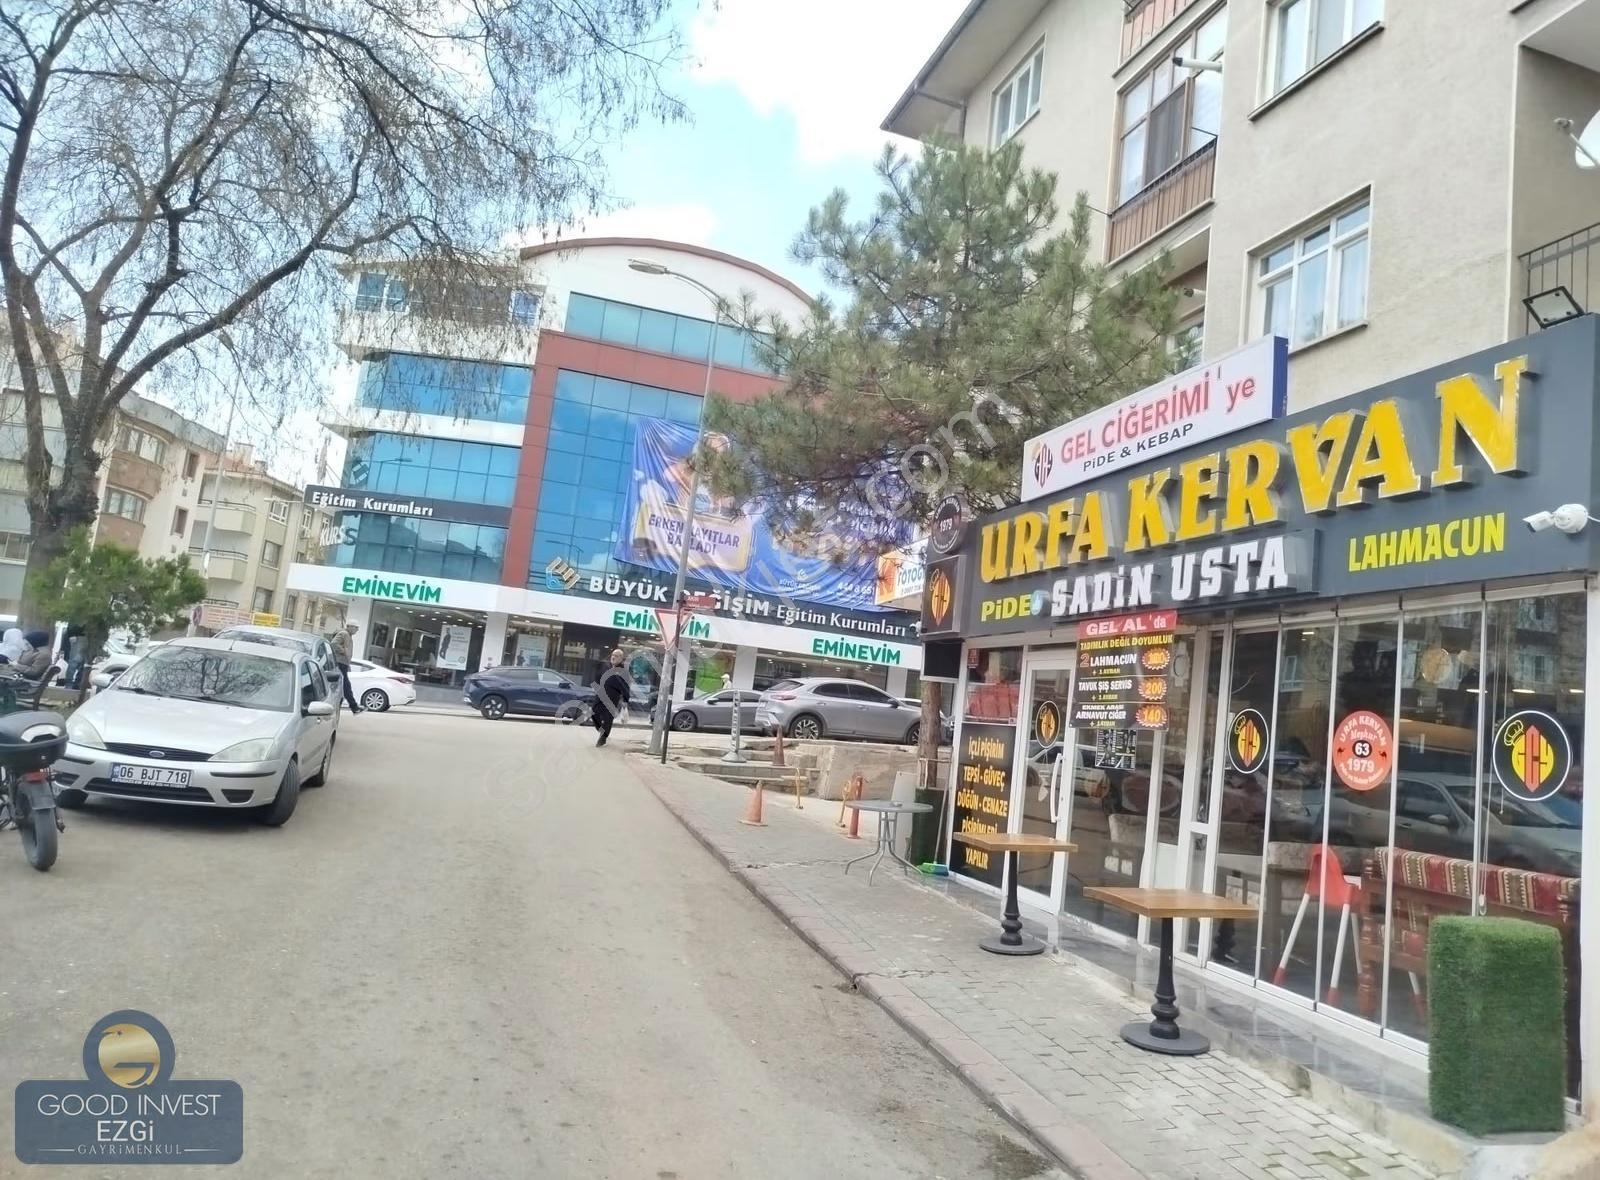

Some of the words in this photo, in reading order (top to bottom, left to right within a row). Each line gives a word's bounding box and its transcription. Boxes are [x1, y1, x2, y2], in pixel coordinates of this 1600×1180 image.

[1061, 435, 1096, 464] GEL
[1101, 372, 1210, 449] CİĞERİMİ
[1120, 446, 1131, 459] &
[1137, 422, 1193, 453] KEBAP
[980, 490, 1110, 583] URFA
[1125, 354, 1528, 553] KERVAN
[312, 491, 357, 509] Eğitim
[363, 497, 433, 517] Kurumları
[648, 513, 684, 533] ERKEN
[667, 532, 717, 556] BALADI
[1348, 512, 1506, 572] LAHMACUN
[1170, 536, 1289, 601] USTA
[341, 575, 442, 603] EMİNEVİM
[589, 574, 668, 602] BÜYÜK
[682, 588, 770, 617] ĞİŞİM
[776, 604, 826, 627] Eğitim
[830, 612, 906, 637] Kurumları
[612, 610, 710, 639] EMİNİM
[1086, 621, 1118, 636] GEL
[1122, 617, 1147, 632] AL
[812, 637, 902, 665] EMİNEVİM
[1109, 636, 1131, 648] DEĞİL
[1131, 634, 1173, 645] DOYUMLUK
[1079, 653, 1090, 668] 2
[1090, 653, 1138, 667] LAHMACUN
[1078, 681, 1098, 691] TAVUK
[1110, 680, 1133, 690] SERVİS
[1145, 682, 1162, 694] 200
[1075, 710, 1108, 720] ARNAVUT
[1143, 709, 1160, 721] 140
[1339, 717, 1358, 743] URFA
[1358, 715, 1387, 746] KERVAN
[981, 737, 1004, 762] PİŞİRİM
[1354, 742, 1370, 756] 63
[120, 766, 134, 778] 06
[140, 768, 162, 780] BJT
[167, 770, 188, 783] 718
[963, 763, 980, 783] TEPSİ
[983, 765, 1006, 792] GÜVEÇ
[1346, 757, 1375, 773] 1979
[957, 788, 979, 811] DÜĞÜN
[982, 796, 1008, 817] CENAZE
[965, 847, 989, 870] YAPILIR
